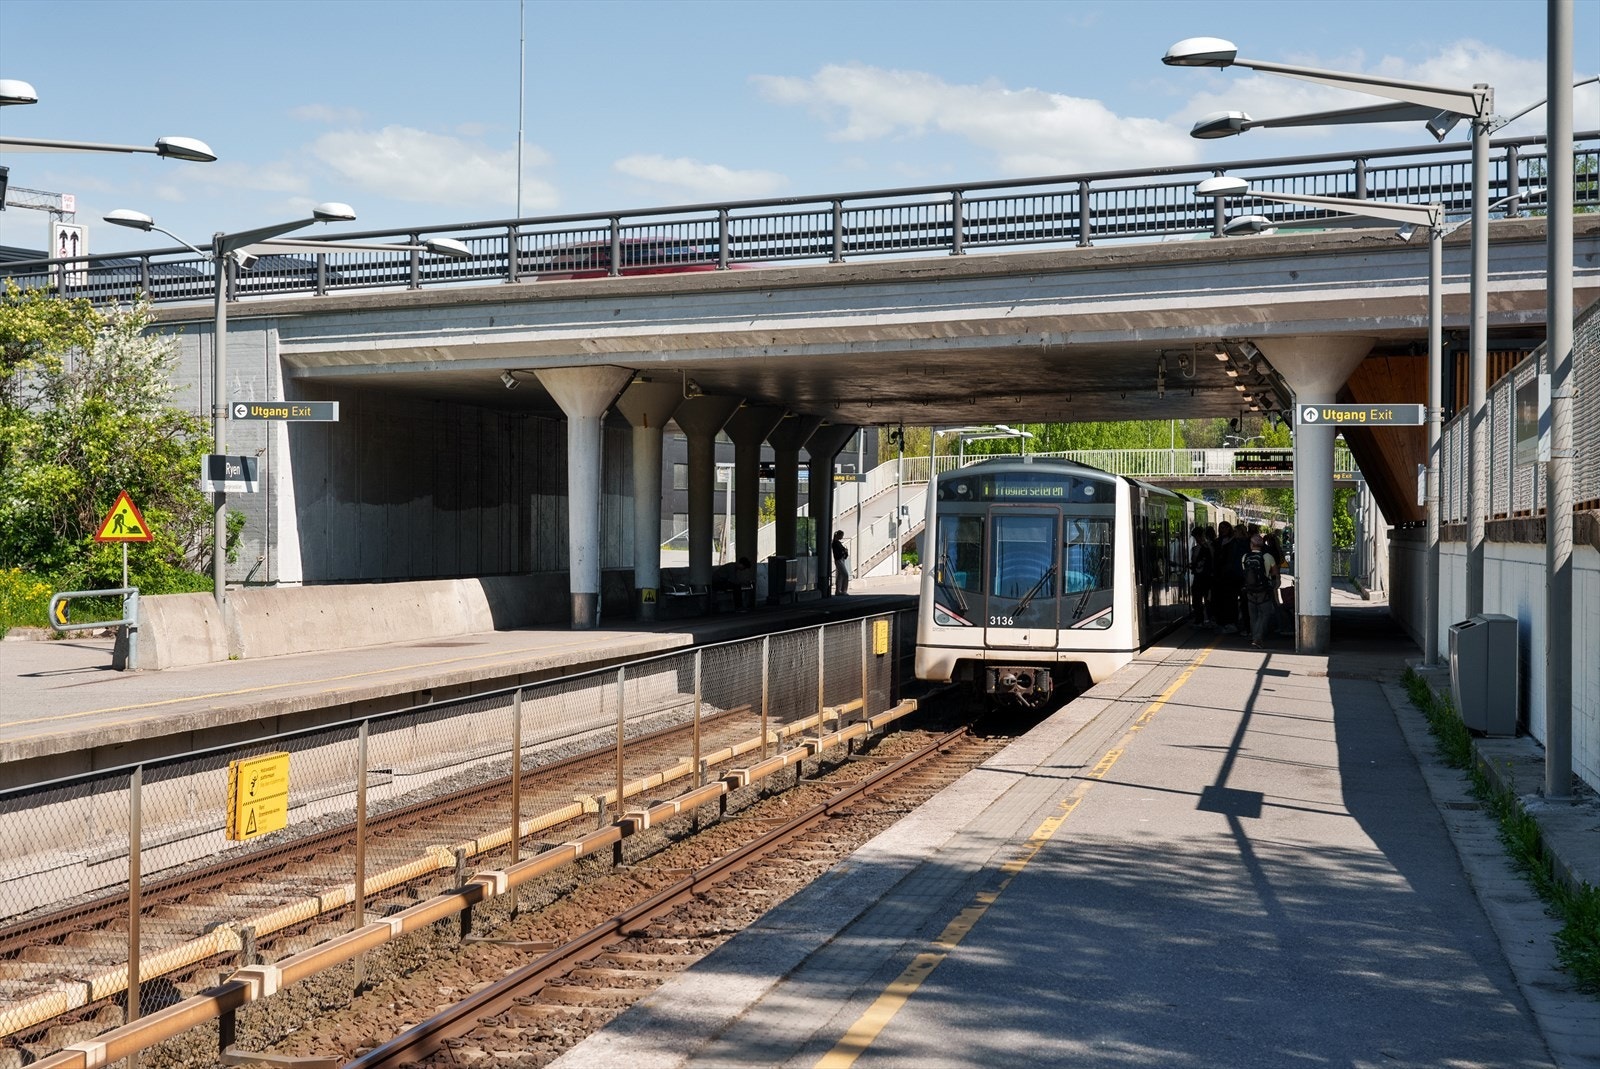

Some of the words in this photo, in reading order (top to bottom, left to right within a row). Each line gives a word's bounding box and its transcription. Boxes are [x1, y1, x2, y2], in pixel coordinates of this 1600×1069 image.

[251, 406, 288, 418] Utgang
[292, 406, 311, 416] Exit
[1322, 409, 1366, 422] Utgang
[1370, 409, 1393, 420] Exit
[226, 462, 240, 478] Ryen
[990, 615, 1014, 626] 3136
